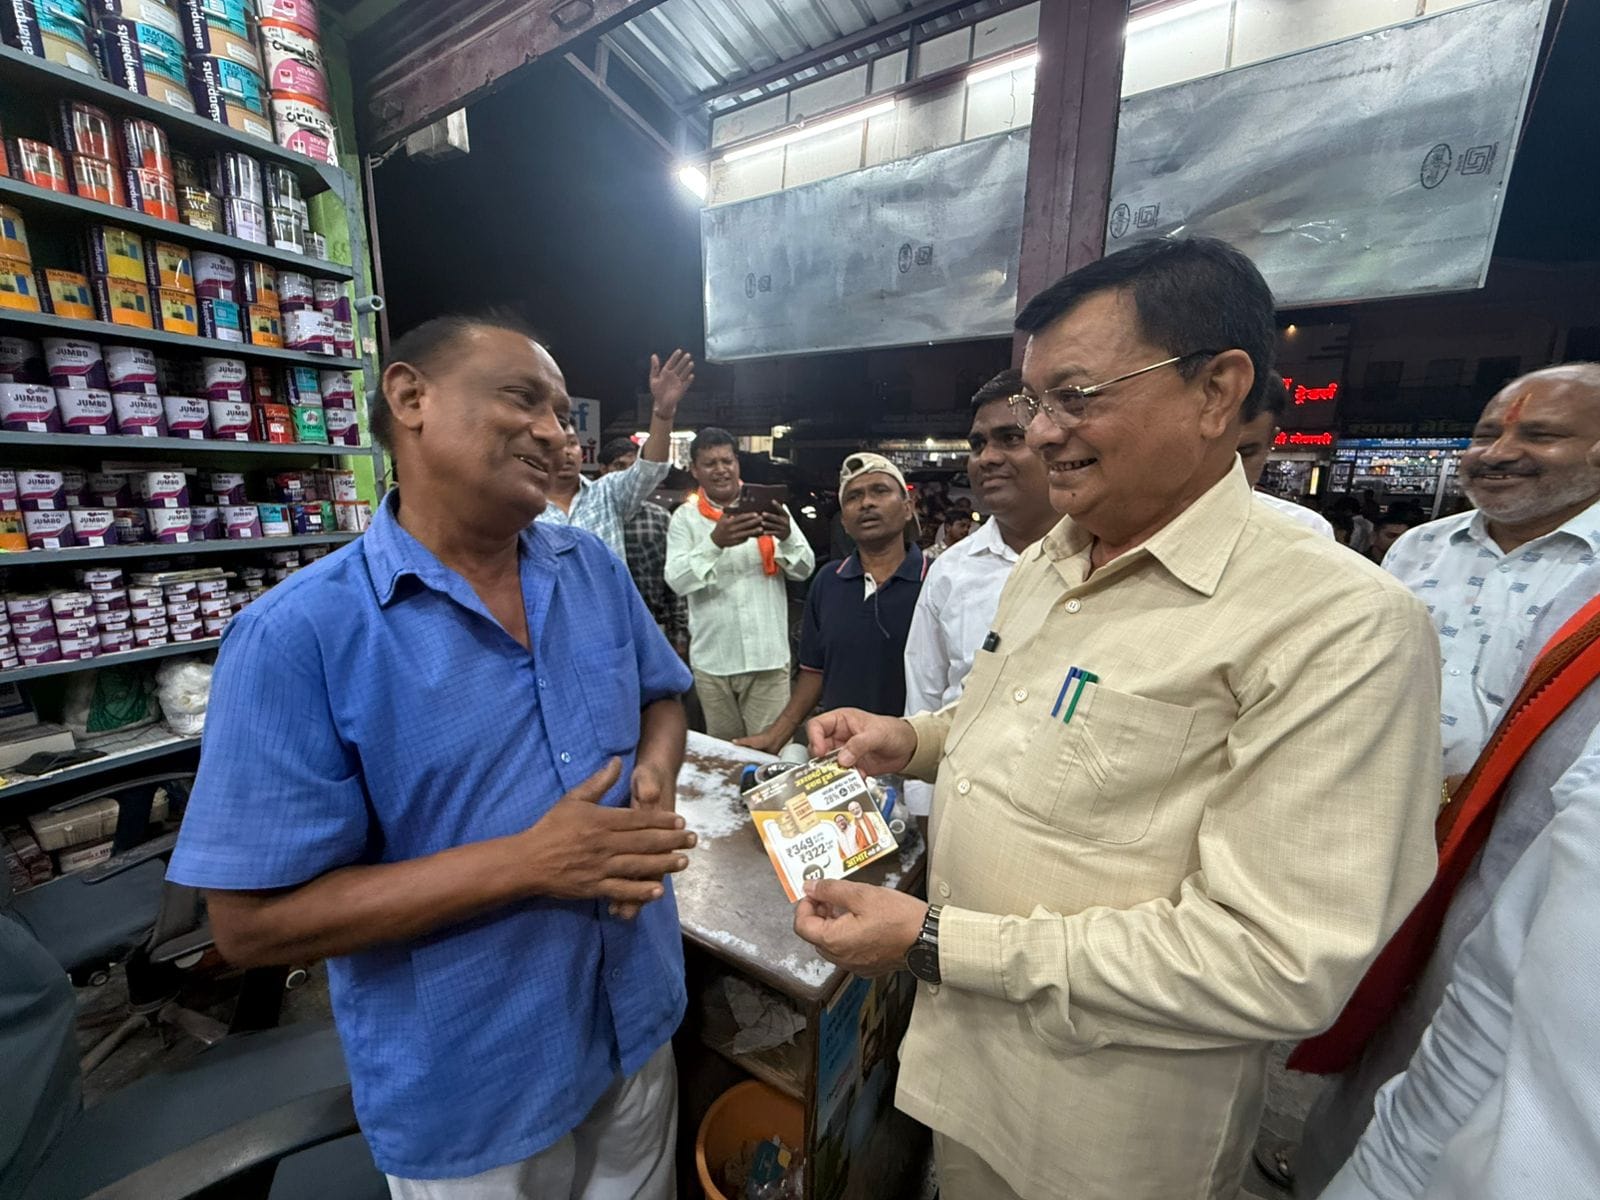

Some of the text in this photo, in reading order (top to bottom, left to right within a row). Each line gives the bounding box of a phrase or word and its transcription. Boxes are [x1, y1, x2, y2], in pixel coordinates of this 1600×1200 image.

[117, 24, 139, 93] asianpaints
[56, 348, 89, 358] JUMBO
[218, 365, 243, 374] JUMBO
[13, 393, 48, 404] JUMBO
[76, 399, 107, 408] JUMBO
[129, 400, 157, 410] JUMBO
[179, 405, 205, 414] JUMBO
[226, 409, 249, 418] JUMBO
[27, 478, 56, 486] JUMBO
[32, 517, 62, 525] JUMBO
[80, 516, 106, 524] JUMBO
[824, 792, 840, 805] 28%
[847, 781, 862, 793] 18%
[785, 836, 814, 858] ₹349
[799, 843, 828, 864] ₹322
